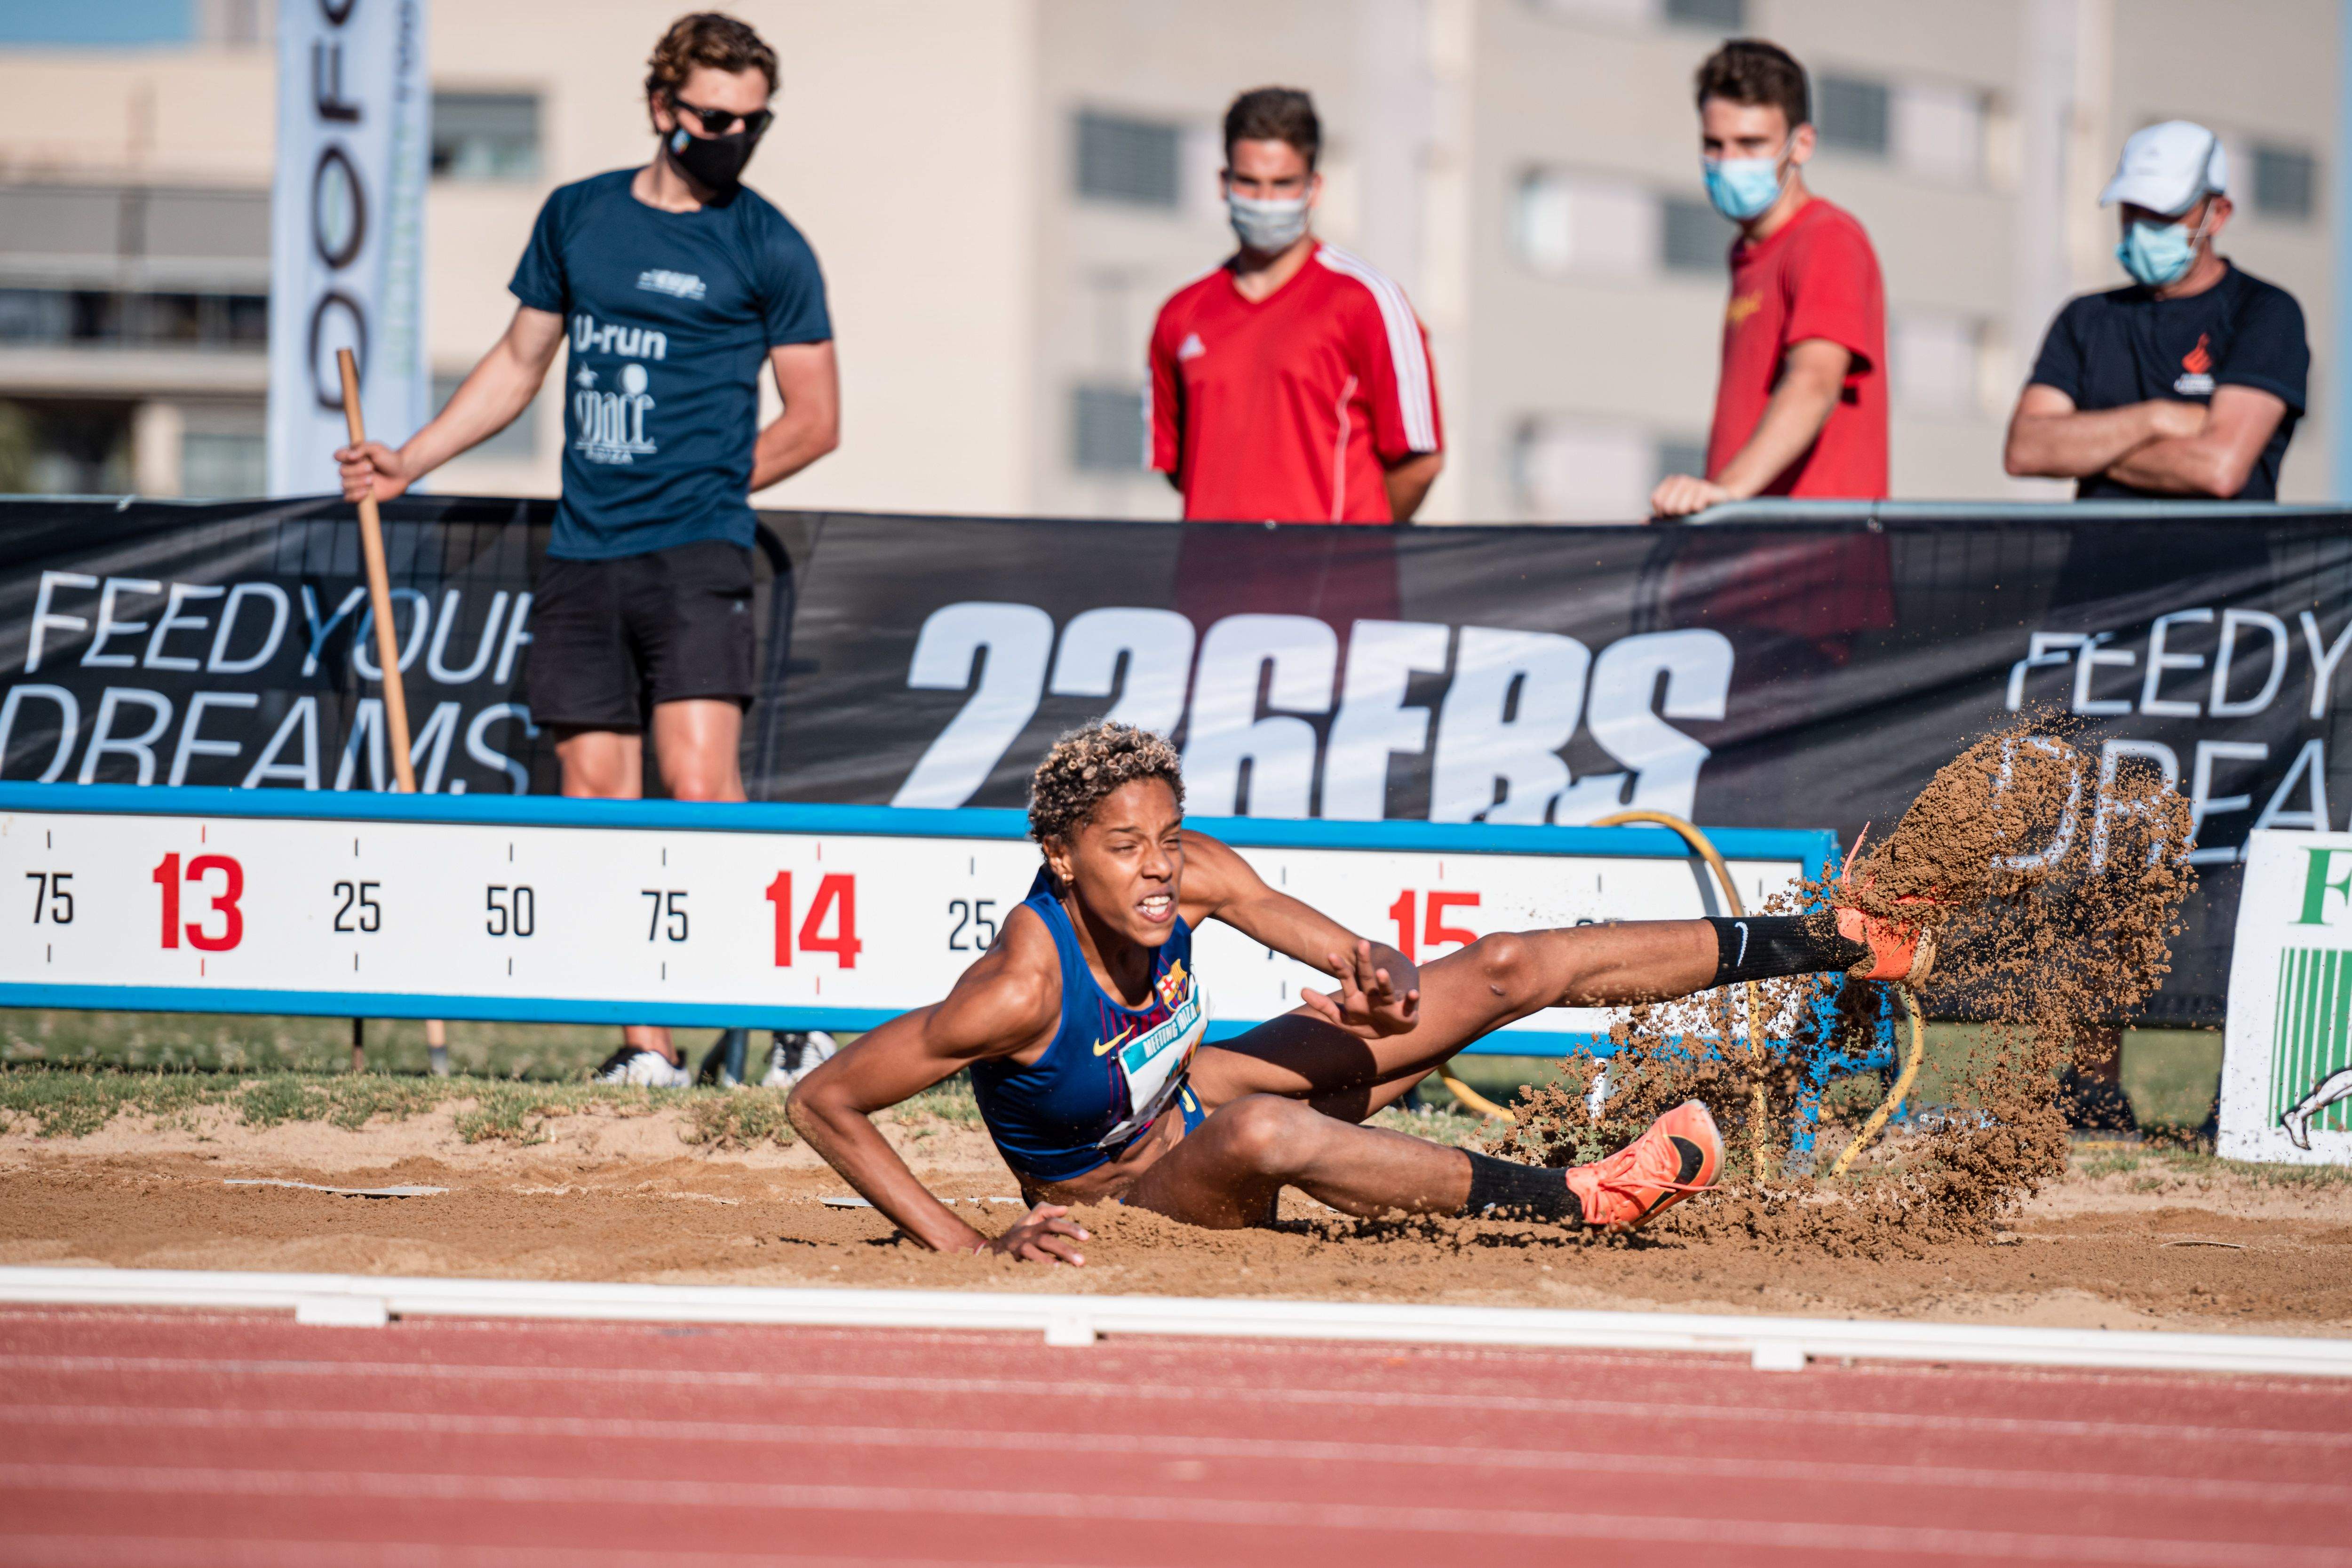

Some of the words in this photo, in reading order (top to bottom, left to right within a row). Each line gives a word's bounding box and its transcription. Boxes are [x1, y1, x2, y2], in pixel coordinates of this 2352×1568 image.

[572, 314, 667, 360] U-run
[25, 873, 74, 924] 75
[152, 852, 245, 951] 13
[333, 881, 381, 933] 25
[486, 885, 535, 937] 50
[641, 890, 689, 942] 75
[765, 870, 862, 970] 14
[948, 899, 996, 951] 25
[1389, 889, 1480, 964] 15
